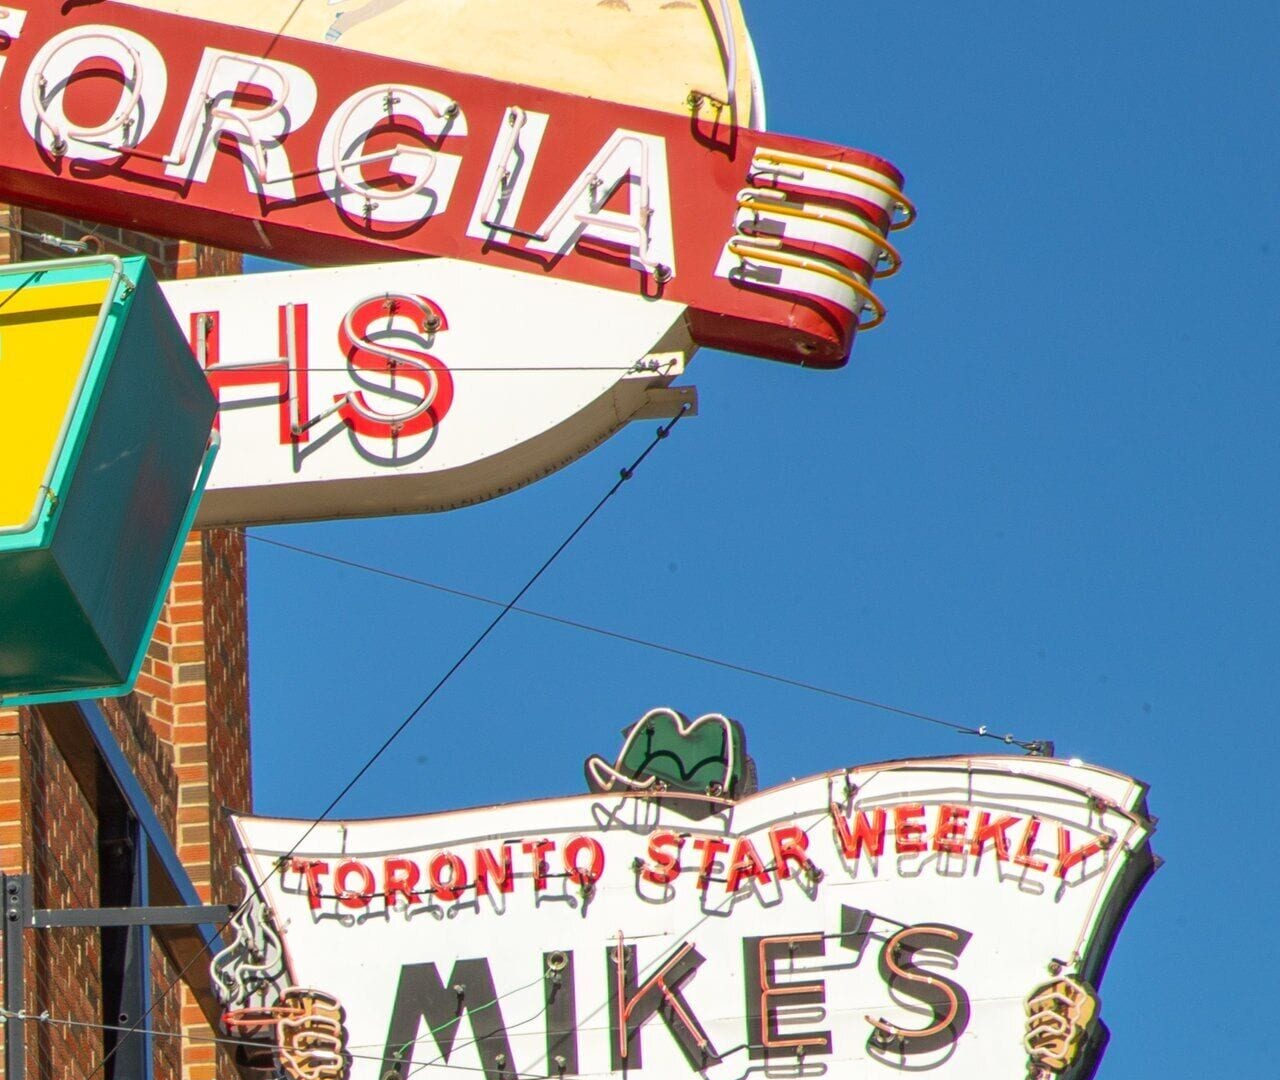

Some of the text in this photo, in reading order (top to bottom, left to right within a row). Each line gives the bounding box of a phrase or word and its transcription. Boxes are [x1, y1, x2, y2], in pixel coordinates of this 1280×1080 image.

[291, 802, 1112, 909] TORONTO STAR WEEKLY
